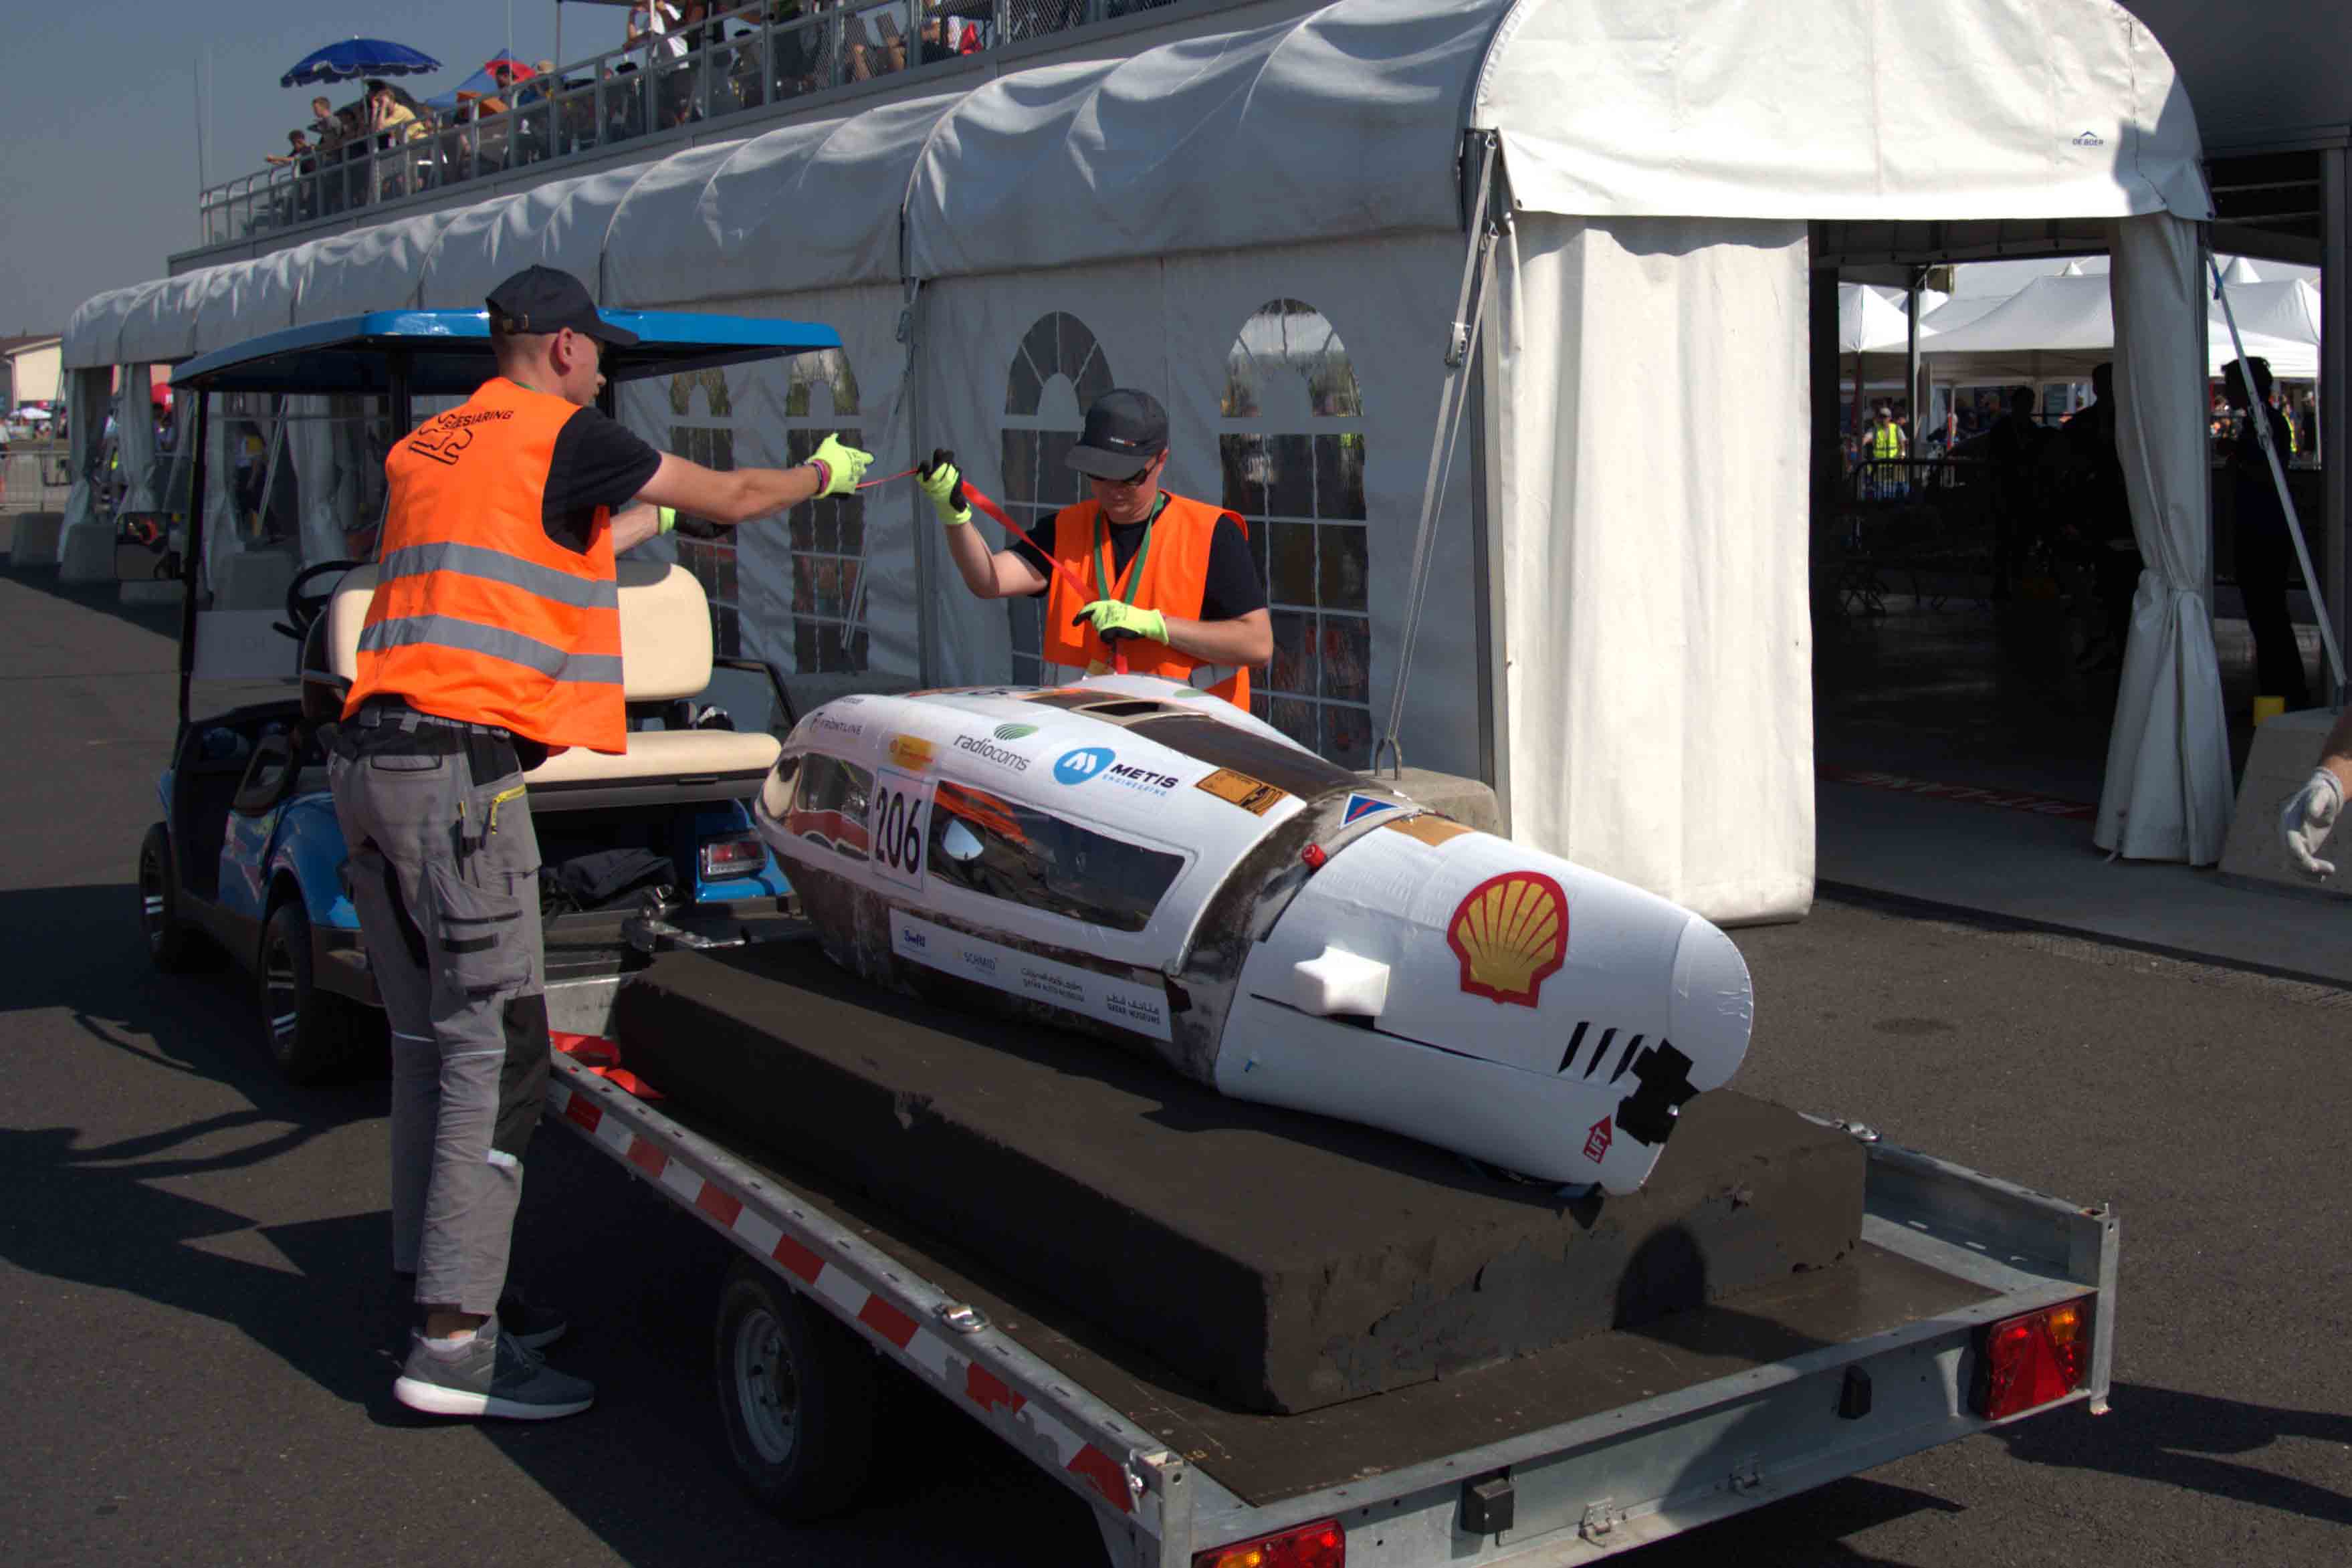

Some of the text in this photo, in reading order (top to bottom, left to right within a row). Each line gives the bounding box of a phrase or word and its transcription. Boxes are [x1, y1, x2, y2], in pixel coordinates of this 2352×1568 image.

[953, 734, 1031, 771] radiocoms
[1109, 764, 1179, 788] METIS
[875, 786, 921, 875] 206
